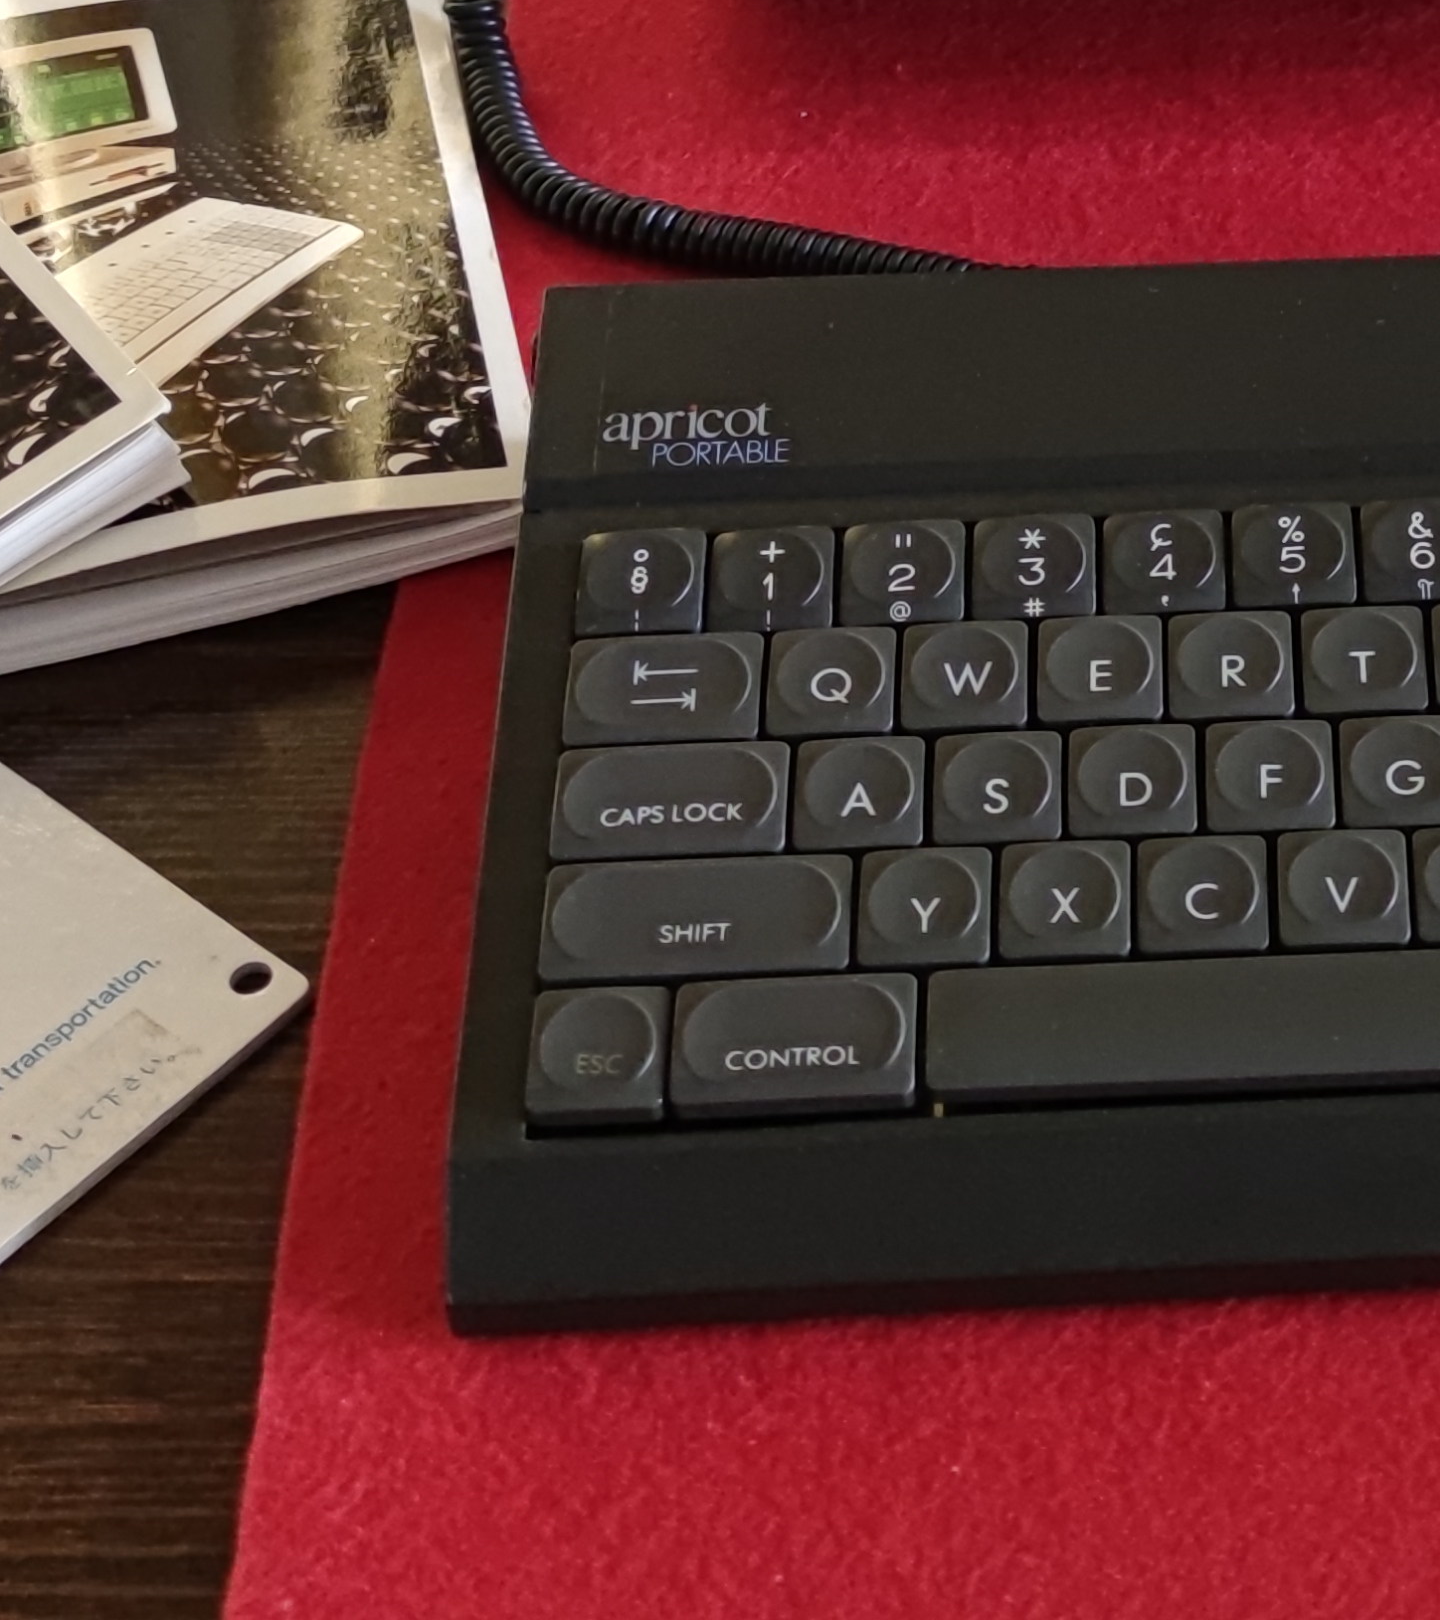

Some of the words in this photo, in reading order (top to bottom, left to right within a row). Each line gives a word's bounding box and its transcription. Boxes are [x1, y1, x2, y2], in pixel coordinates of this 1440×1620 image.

[602, 402, 772, 459] apricot
[651, 438, 791, 467] PORTABLE
[943, 661, 992, 696] W
[1089, 659, 1112, 692] E
[1221, 654, 1246, 687] R
[1348, 650, 1376, 683] T
[810, 667, 852, 703] Q
[1119, 772, 1153, 807] D
[1259, 763, 1282, 798] F
[1385, 759, 1425, 795] G
[840, 782, 876, 817] A
[983, 778, 1009, 814] S
[599, 805, 665, 828] CAPS
[671, 802, 742, 823] LOCK
[1050, 887, 1079, 924] X
[1184, 882, 1218, 920] C
[1325, 876, 1358, 913] V
[910, 897, 941, 933] Y
[659, 922, 731, 944] SHIFT
[1, 956, 163, 1082] transportation.
[573, 1052, 622, 1075] ESC
[724, 1045, 859, 1071] CONTROL
